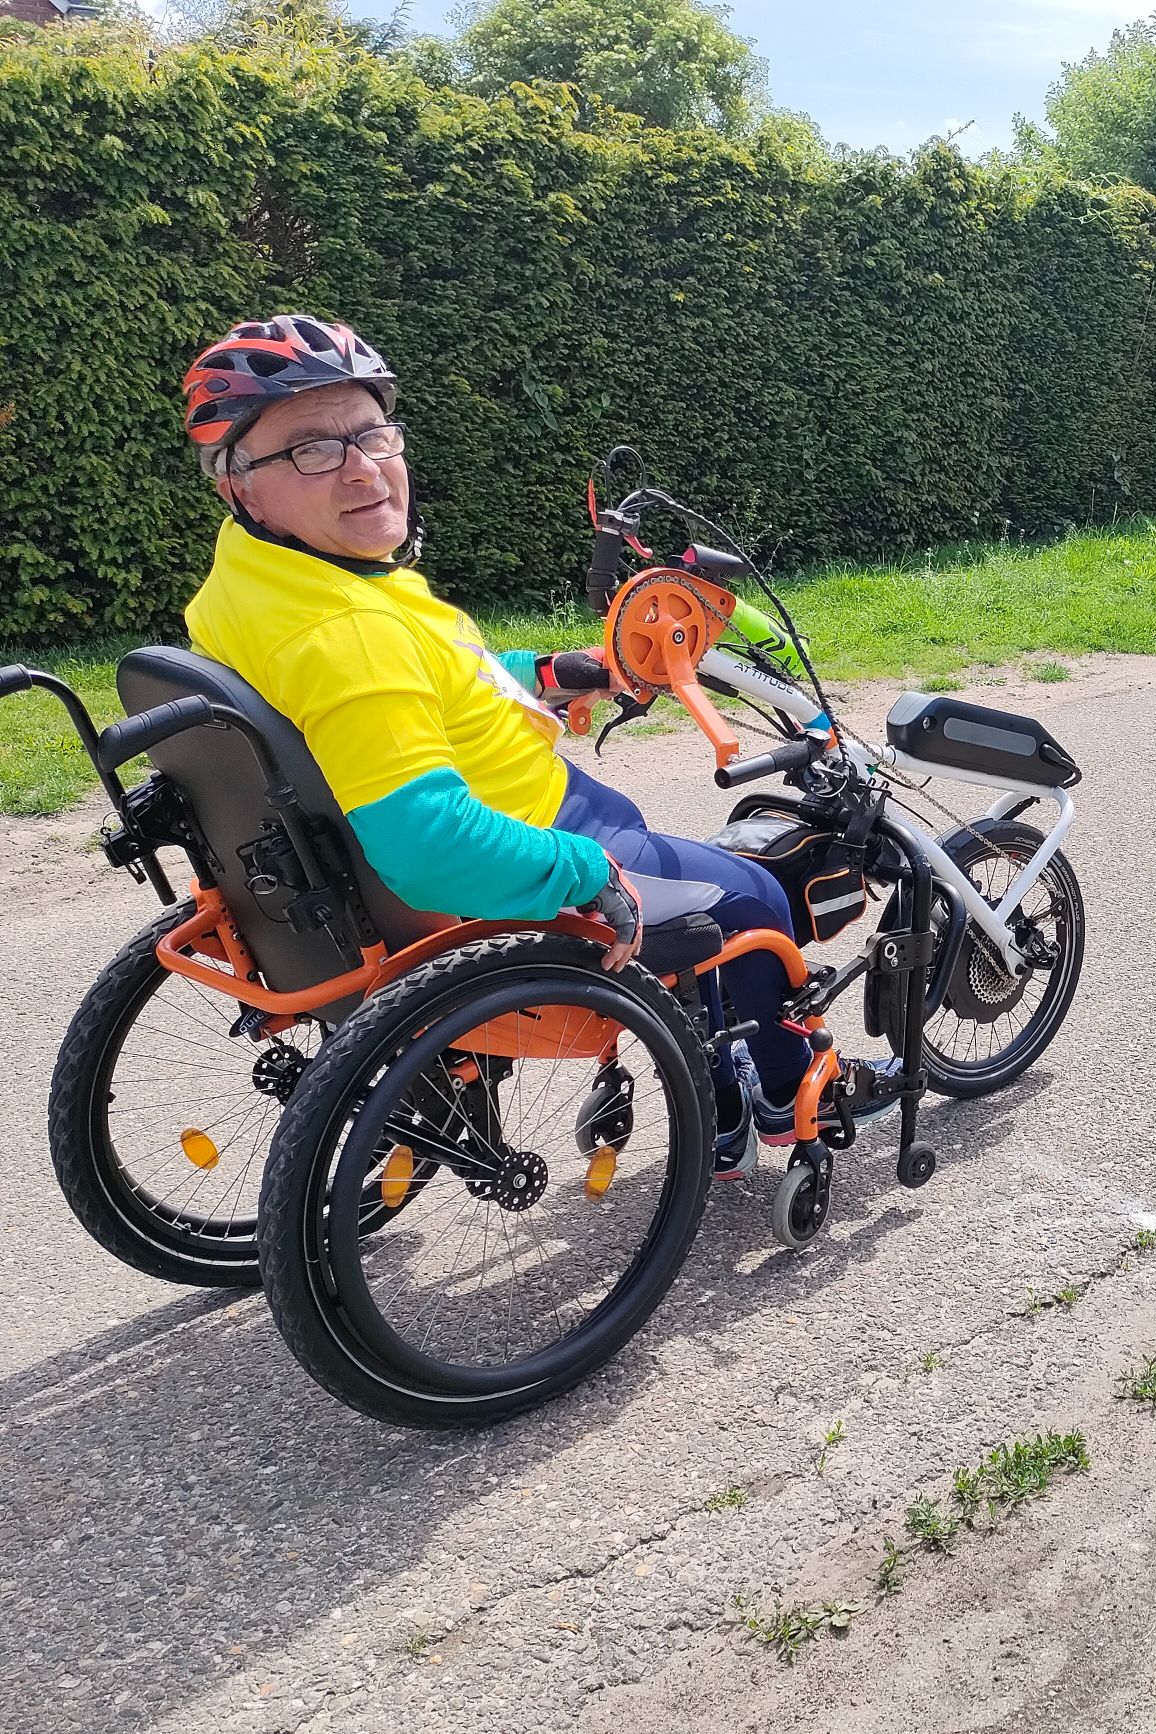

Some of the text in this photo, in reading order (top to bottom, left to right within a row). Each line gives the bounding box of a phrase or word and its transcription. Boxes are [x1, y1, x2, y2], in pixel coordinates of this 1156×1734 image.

[734, 662, 795, 695] ATTITUDE
[1014, 836, 1041, 848] SCHWAL
[239, 1014, 264, 1034] QUIC
